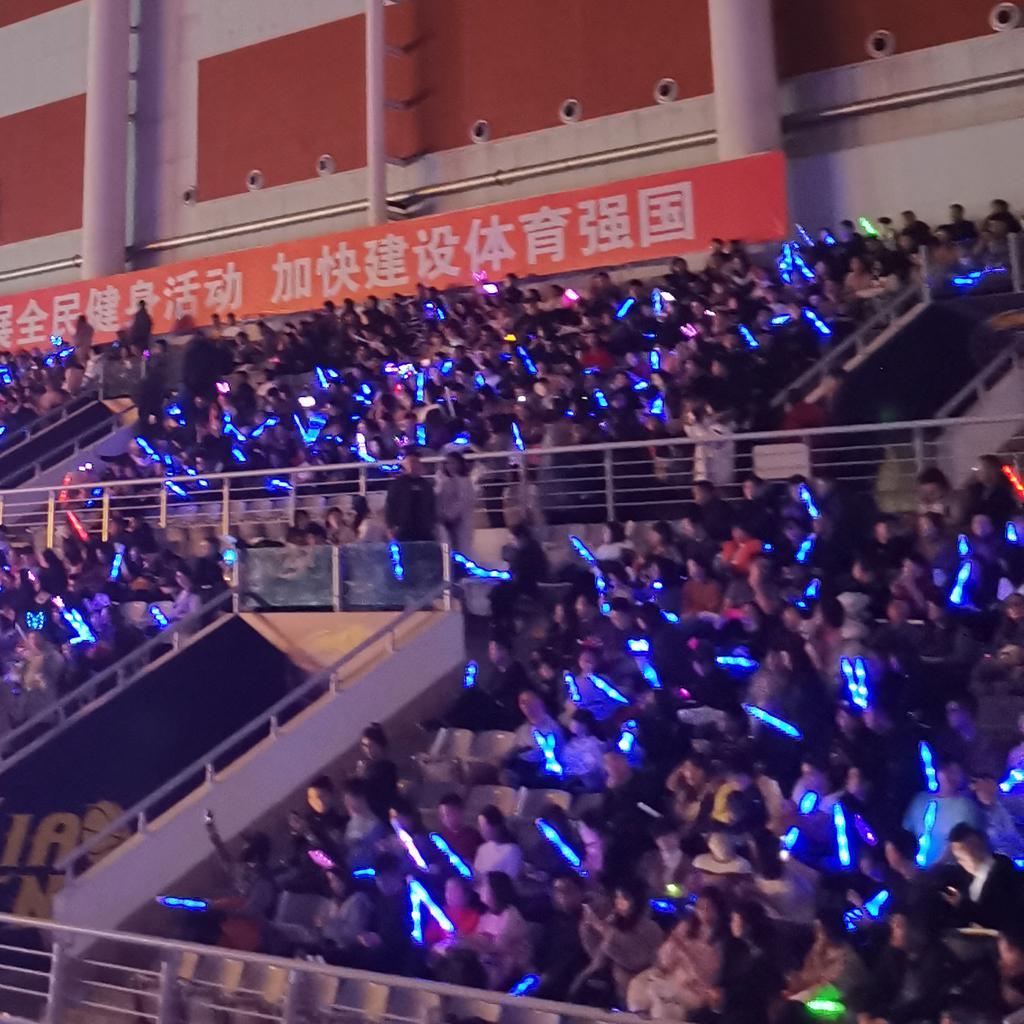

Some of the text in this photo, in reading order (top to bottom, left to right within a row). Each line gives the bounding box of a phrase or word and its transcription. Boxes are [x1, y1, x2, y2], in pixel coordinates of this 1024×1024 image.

[271, 181, 696, 302] 加快建设体育强国
